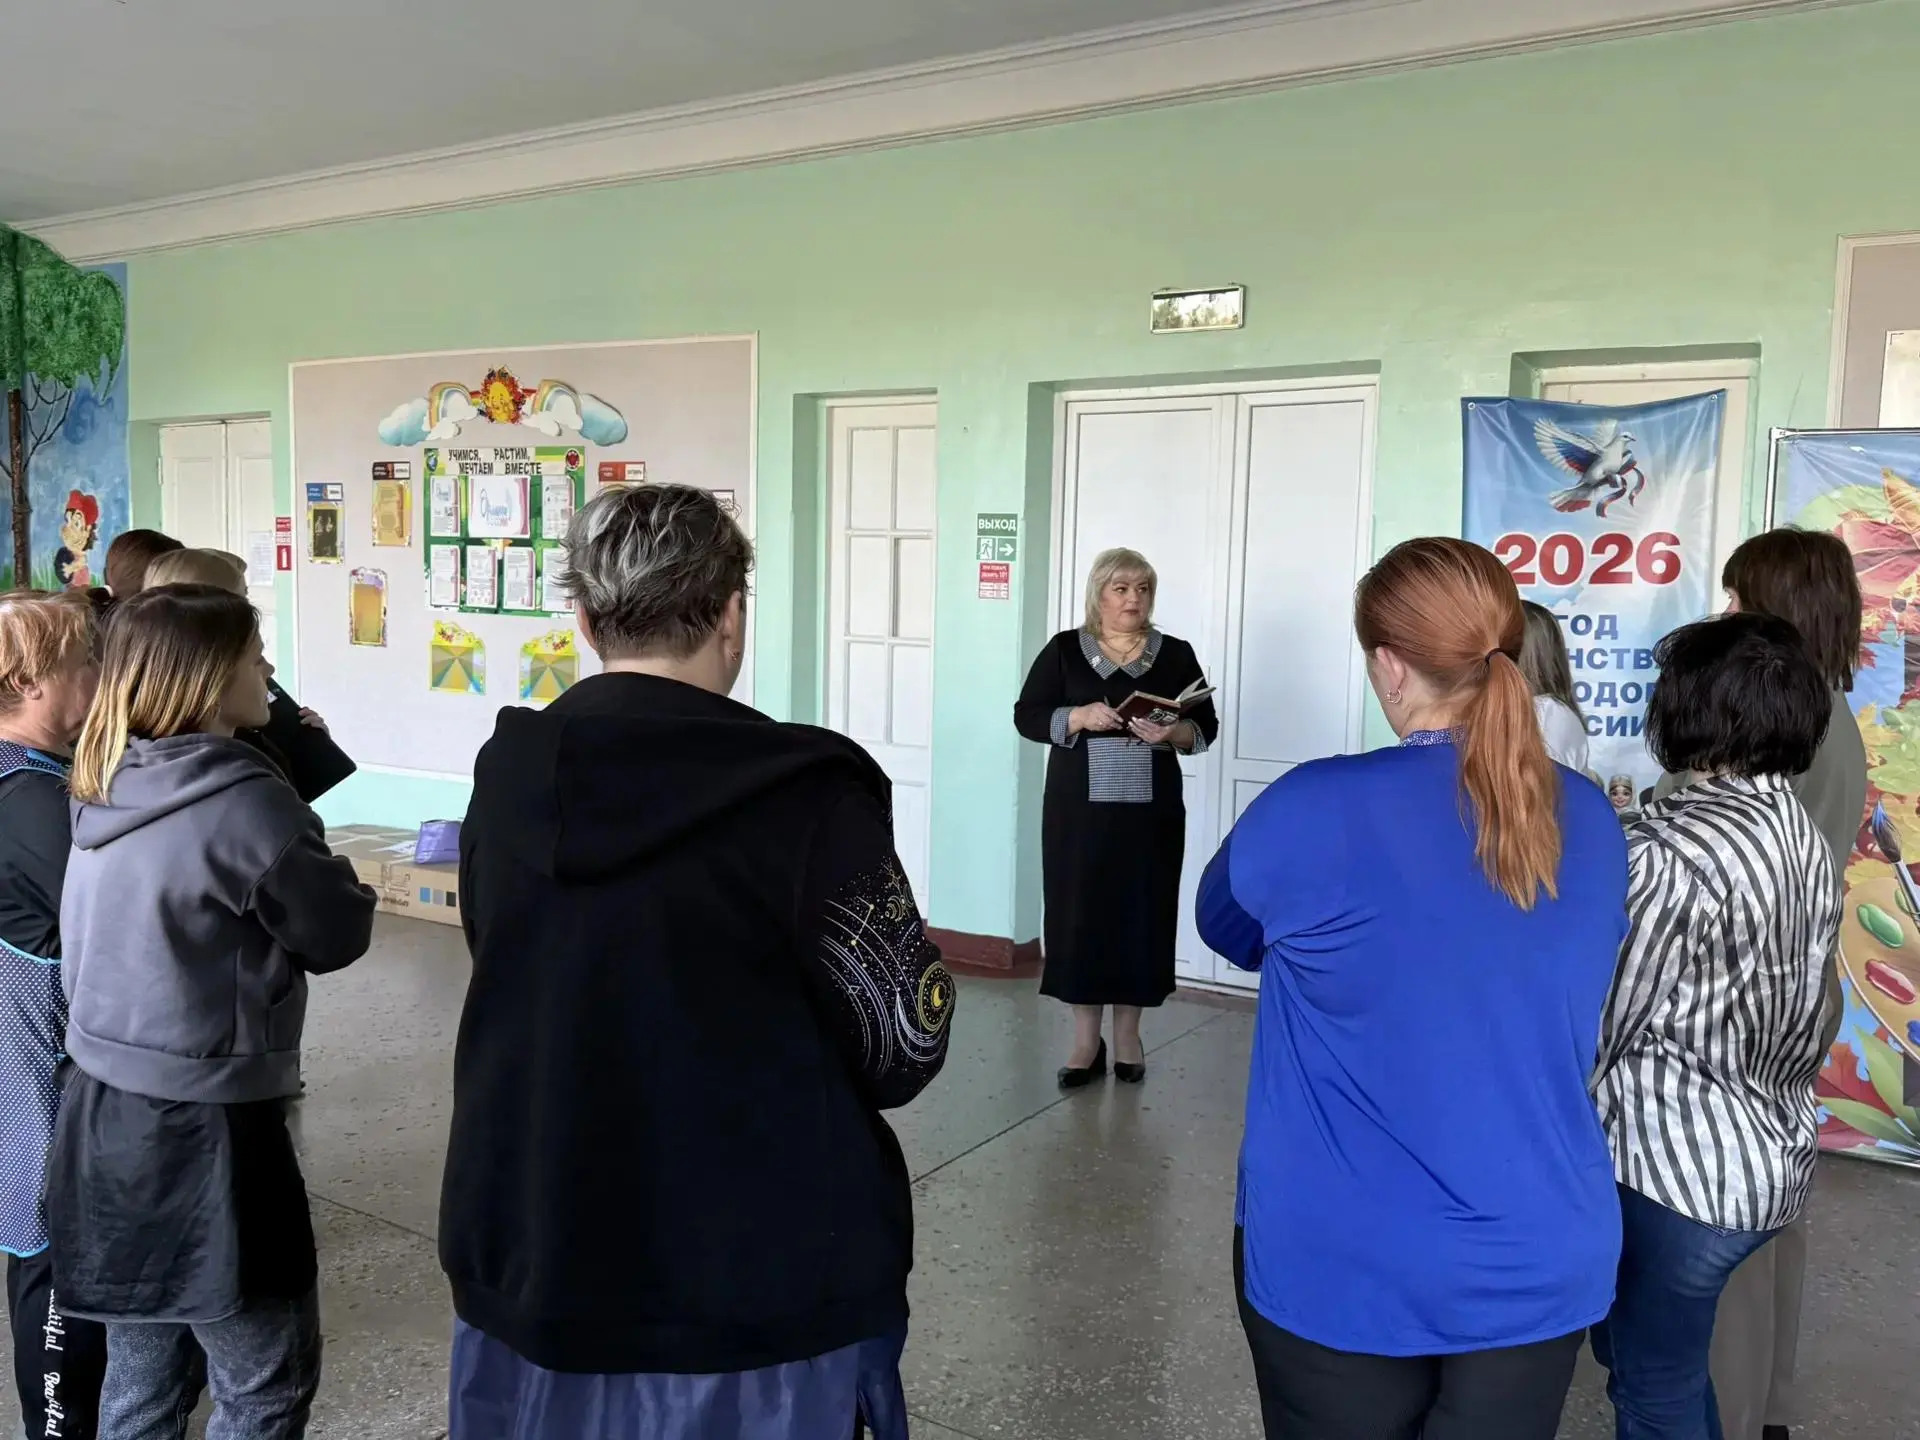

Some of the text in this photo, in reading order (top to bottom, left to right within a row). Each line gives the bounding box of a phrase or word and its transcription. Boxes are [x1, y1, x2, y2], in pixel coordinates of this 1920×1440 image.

[448, 447, 531, 461] УЧИМСЯ, РАСТИМ,
[458, 462, 542, 475] МЕЧТАЕМ ВМЕСТЕ
[978, 518, 1016, 532] ВЫХОД
[1494, 531, 1681, 586] 2026
[1565, 647, 1661, 670] НСТВ
